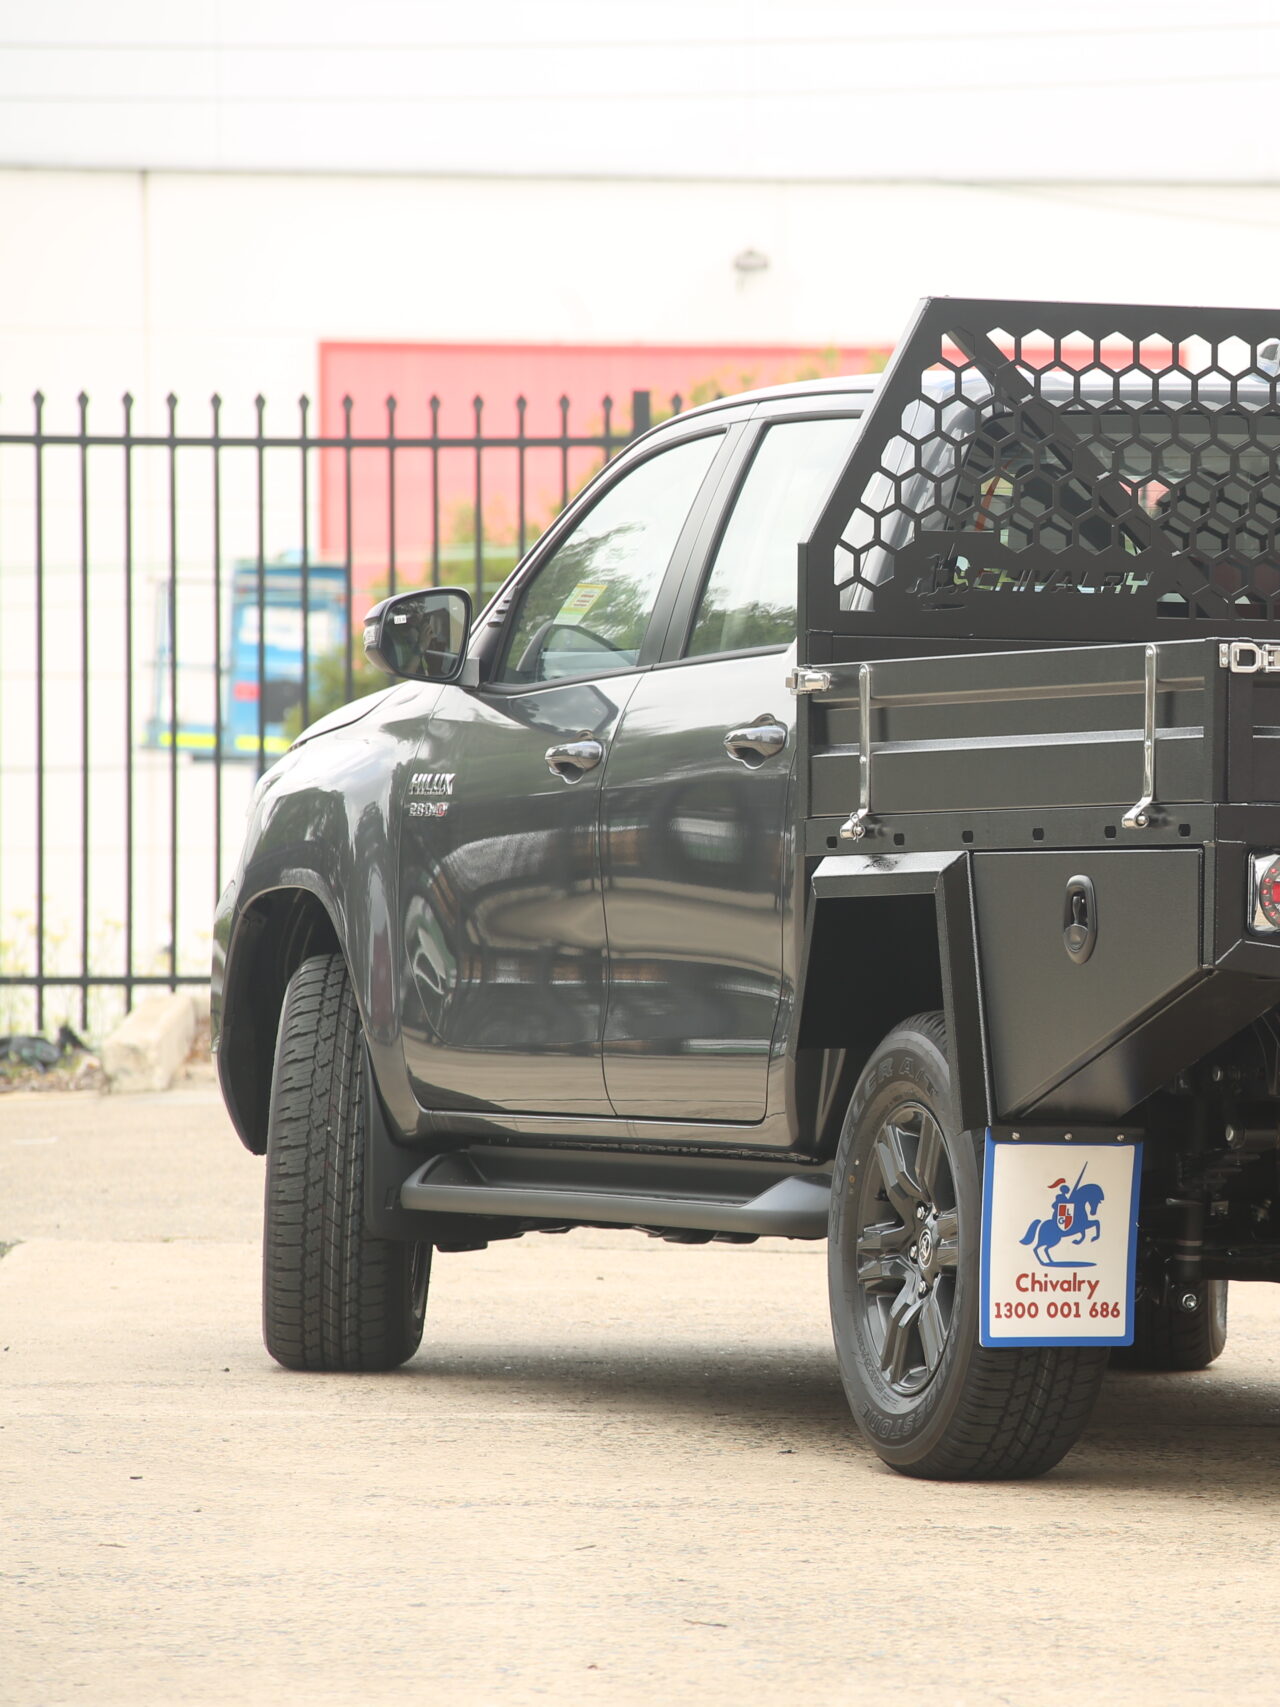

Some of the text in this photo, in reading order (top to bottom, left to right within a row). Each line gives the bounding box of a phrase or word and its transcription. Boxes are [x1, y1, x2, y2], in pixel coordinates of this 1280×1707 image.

[972, 567, 1154, 595] CHIVALRY
[408, 772, 456, 796] HILUX
[1015, 1272, 1100, 1300] Chivalry
[994, 1302, 1121, 1319] 1300 001 686
